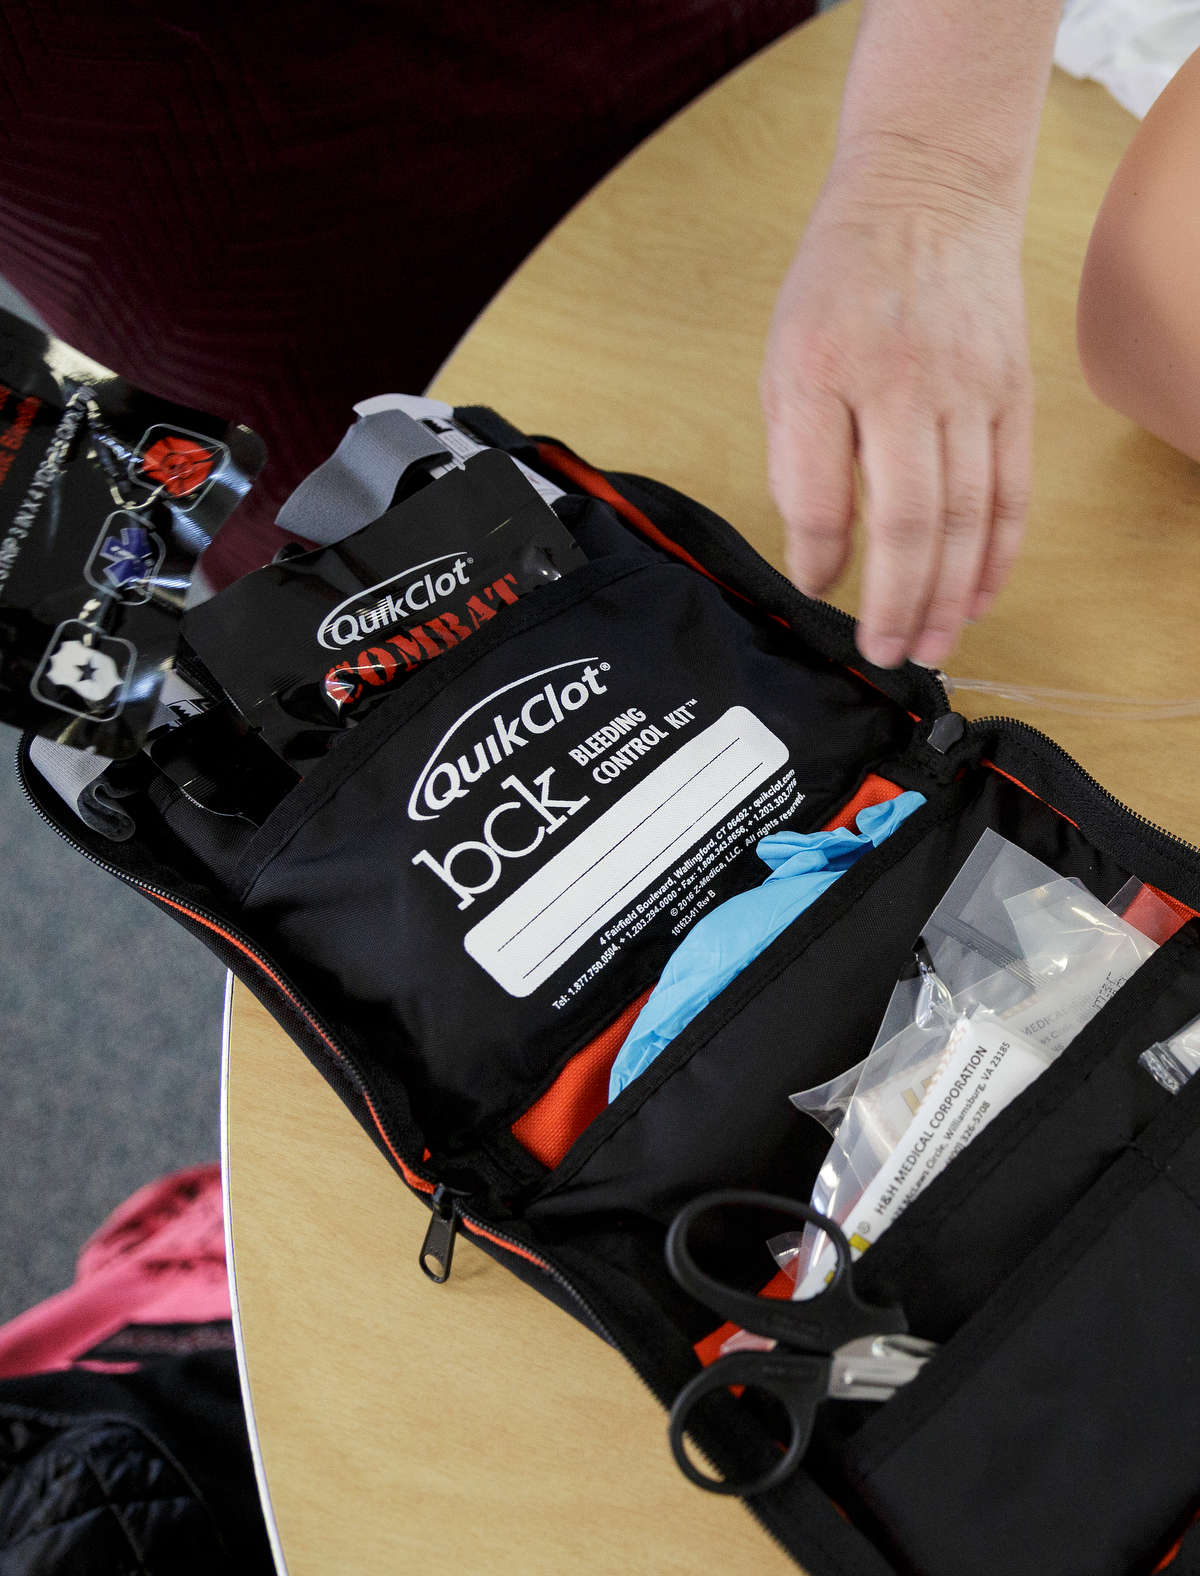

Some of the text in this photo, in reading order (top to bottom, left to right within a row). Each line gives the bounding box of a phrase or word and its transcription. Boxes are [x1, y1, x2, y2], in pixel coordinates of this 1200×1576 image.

[325, 573, 519, 703] COMBAT
[568, 707, 647, 766] BLEEDING
[592, 725, 669, 784] CONTROL
[411, 766, 591, 911] bck
[600, 769, 795, 945] 4 Fairfield Boulevard, Wallingford, CT 06492 quikclot.com
[678, 892, 695, 911] 2016
[693, 863, 728, 894] Z-Medica,
[725, 846, 743, 863] LLC.
[745, 834, 756, 847] All
[757, 818, 779, 839] rights
[779, 792, 806, 821] reserved.
[697, 897, 712, 909] Rev
[708, 889, 716, 898] B
[552, 994, 571, 1010] Tel:
[568, 943, 621, 995] 1.877.750.0504,
[626, 890, 677, 939] 1.203.294.0000
[681, 873, 698, 889] Fax:
[874, 1045, 988, 1215] H&H MEDICAL CORPORATION
[926, 1143, 949, 1170] Circle,
[944, 1083, 987, 1140] Williamsburg,
[981, 1067, 994, 1081] VA
[990, 1041, 1011, 1069] 23185
[960, 1100, 991, 1142] 326-5708
